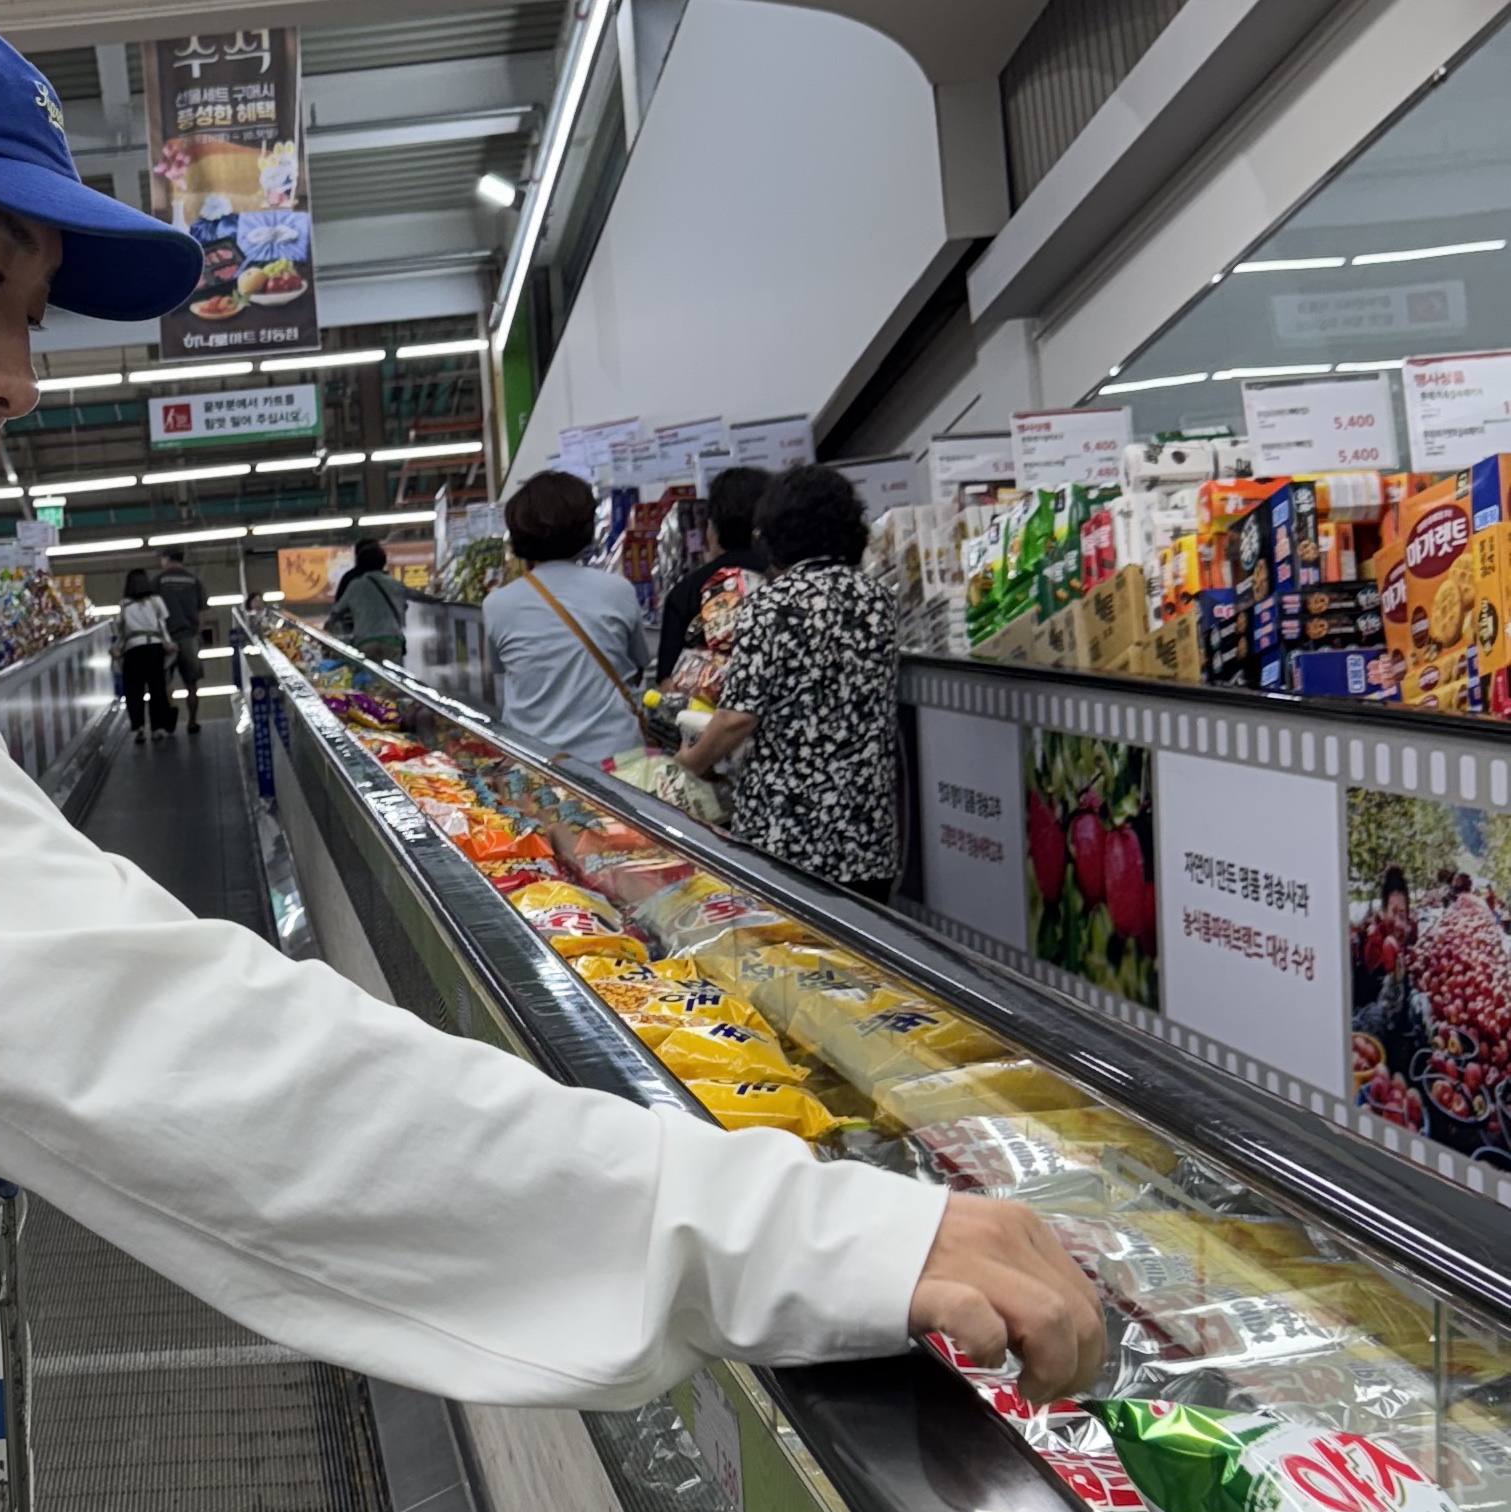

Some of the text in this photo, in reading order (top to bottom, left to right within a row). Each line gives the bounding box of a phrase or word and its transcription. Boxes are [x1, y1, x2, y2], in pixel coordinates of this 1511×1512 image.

[1333, 413, 1376, 431] 5,400
[1338, 447, 1380, 464] 5,400
[1406, 516, 1469, 569] 마가렛트
[1184, 852, 1310, 918] 자연이 만든 명품 청송사과
[1266, 935, 1290, 972] 대상
[1291, 944, 1316, 981] 수상
